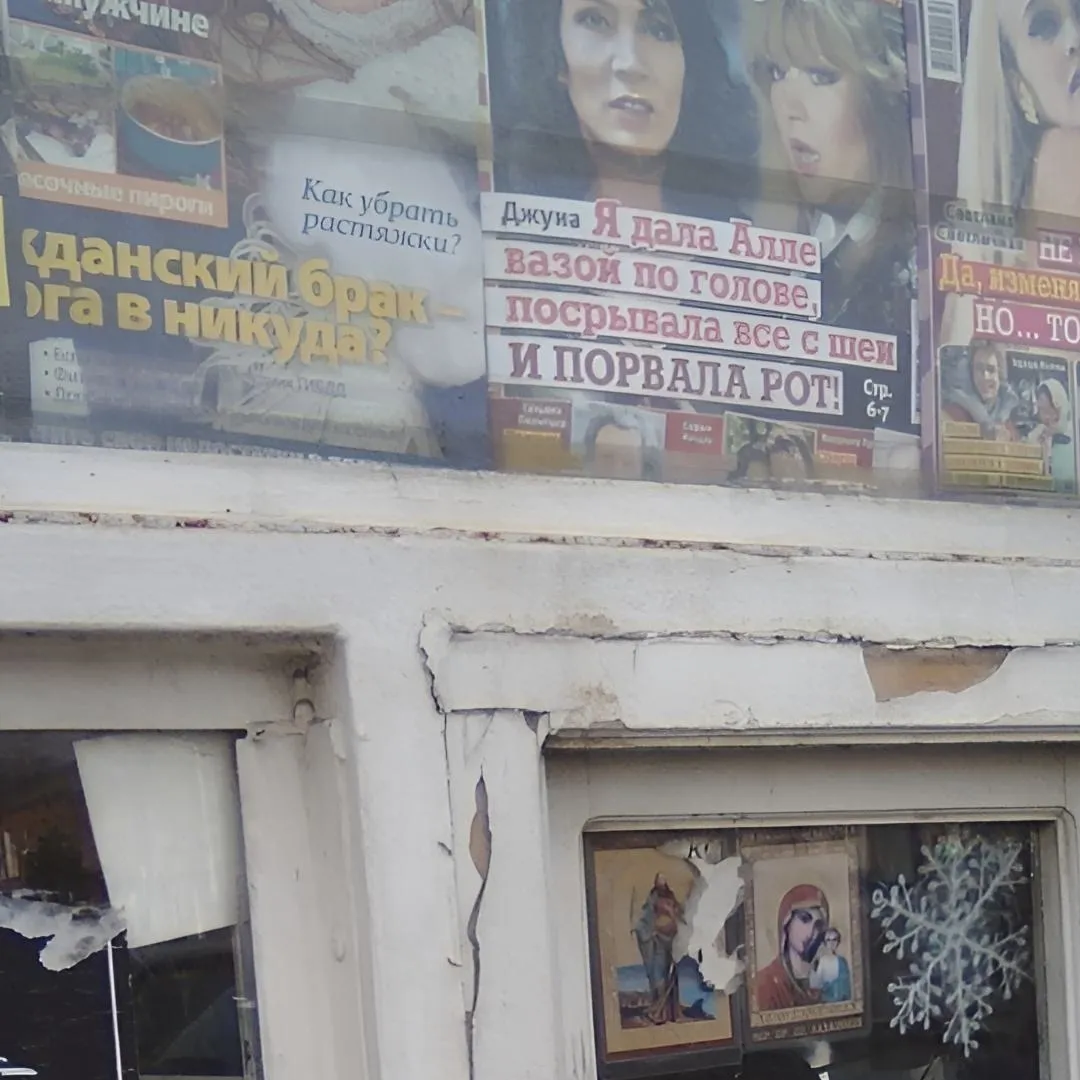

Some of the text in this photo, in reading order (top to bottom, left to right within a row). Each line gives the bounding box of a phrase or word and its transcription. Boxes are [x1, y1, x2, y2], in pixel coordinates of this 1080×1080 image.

[301, 211, 463, 256] растяжки?
[302, 178, 459, 229] Как убрать
[501, 199, 817, 267] Джуна Я дала Алле
[504, 246, 621, 285] вазой
[633, 261, 679, 293] по
[1039, 236, 1073, 263] НЕ
[300, 257, 431, 322] брак
[118, 292, 152, 332] в
[164, 297, 394, 366] никуда?
[505, 294, 896, 366] посрывала все с шеи
[507, 342, 841, 411] И ПОРВАЛА РОТ!
